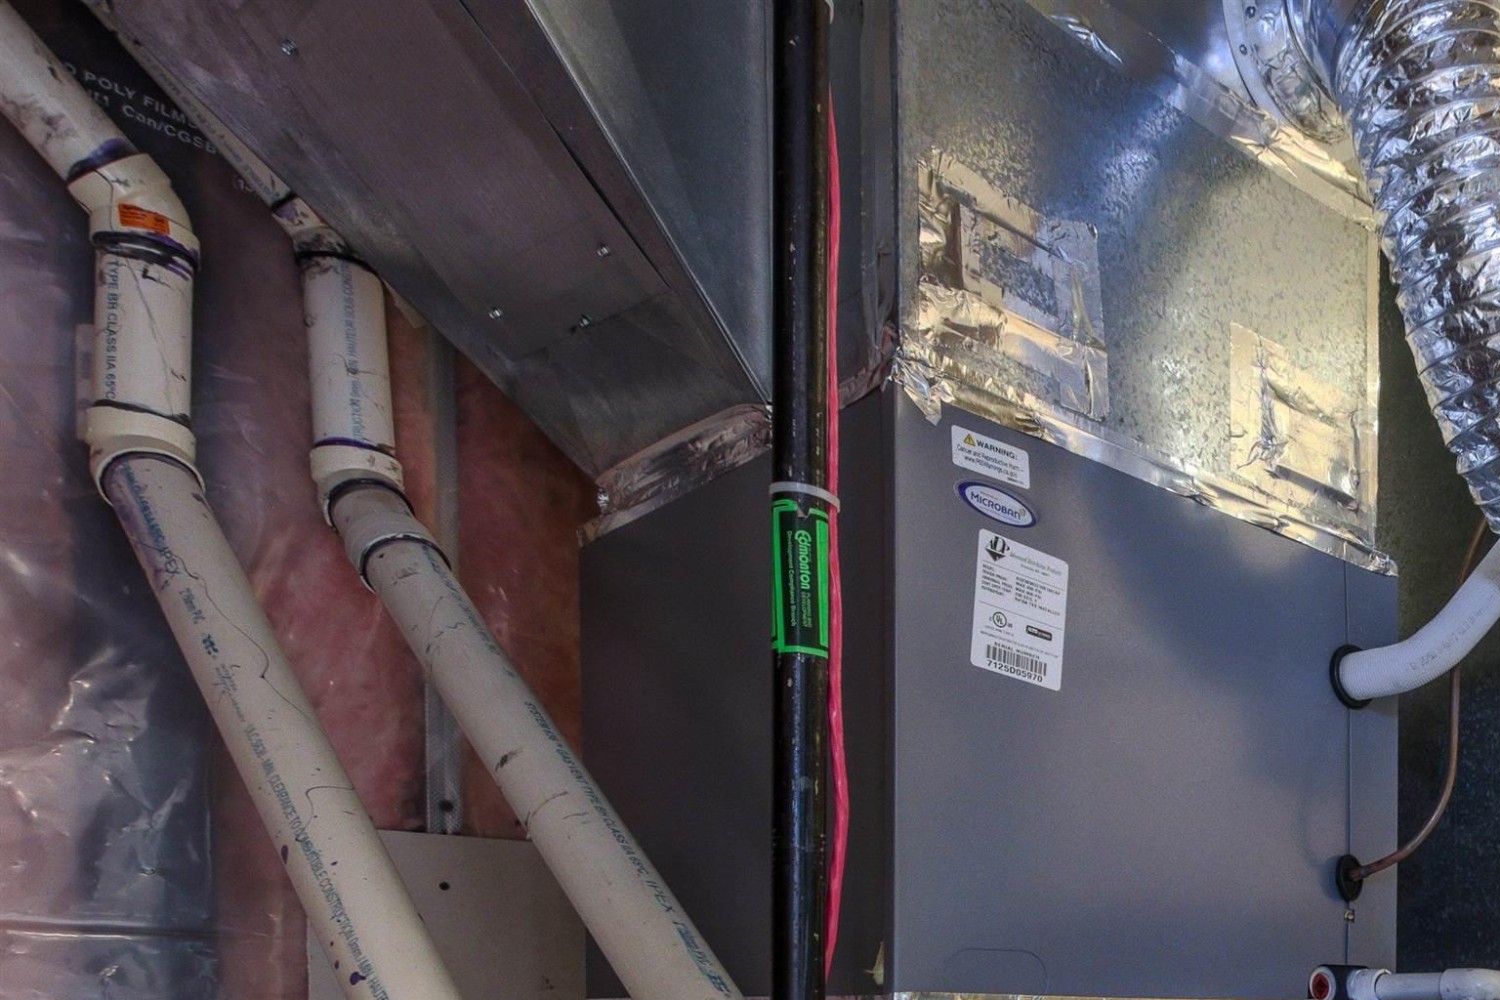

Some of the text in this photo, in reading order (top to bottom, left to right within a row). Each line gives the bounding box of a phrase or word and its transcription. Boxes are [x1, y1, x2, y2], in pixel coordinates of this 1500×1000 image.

[83, 70, 137, 98] POLY
[105, 259, 118, 289] TYPE
[105, 312, 117, 353] CLASS
[792, 528, 815, 591] Edmonton
